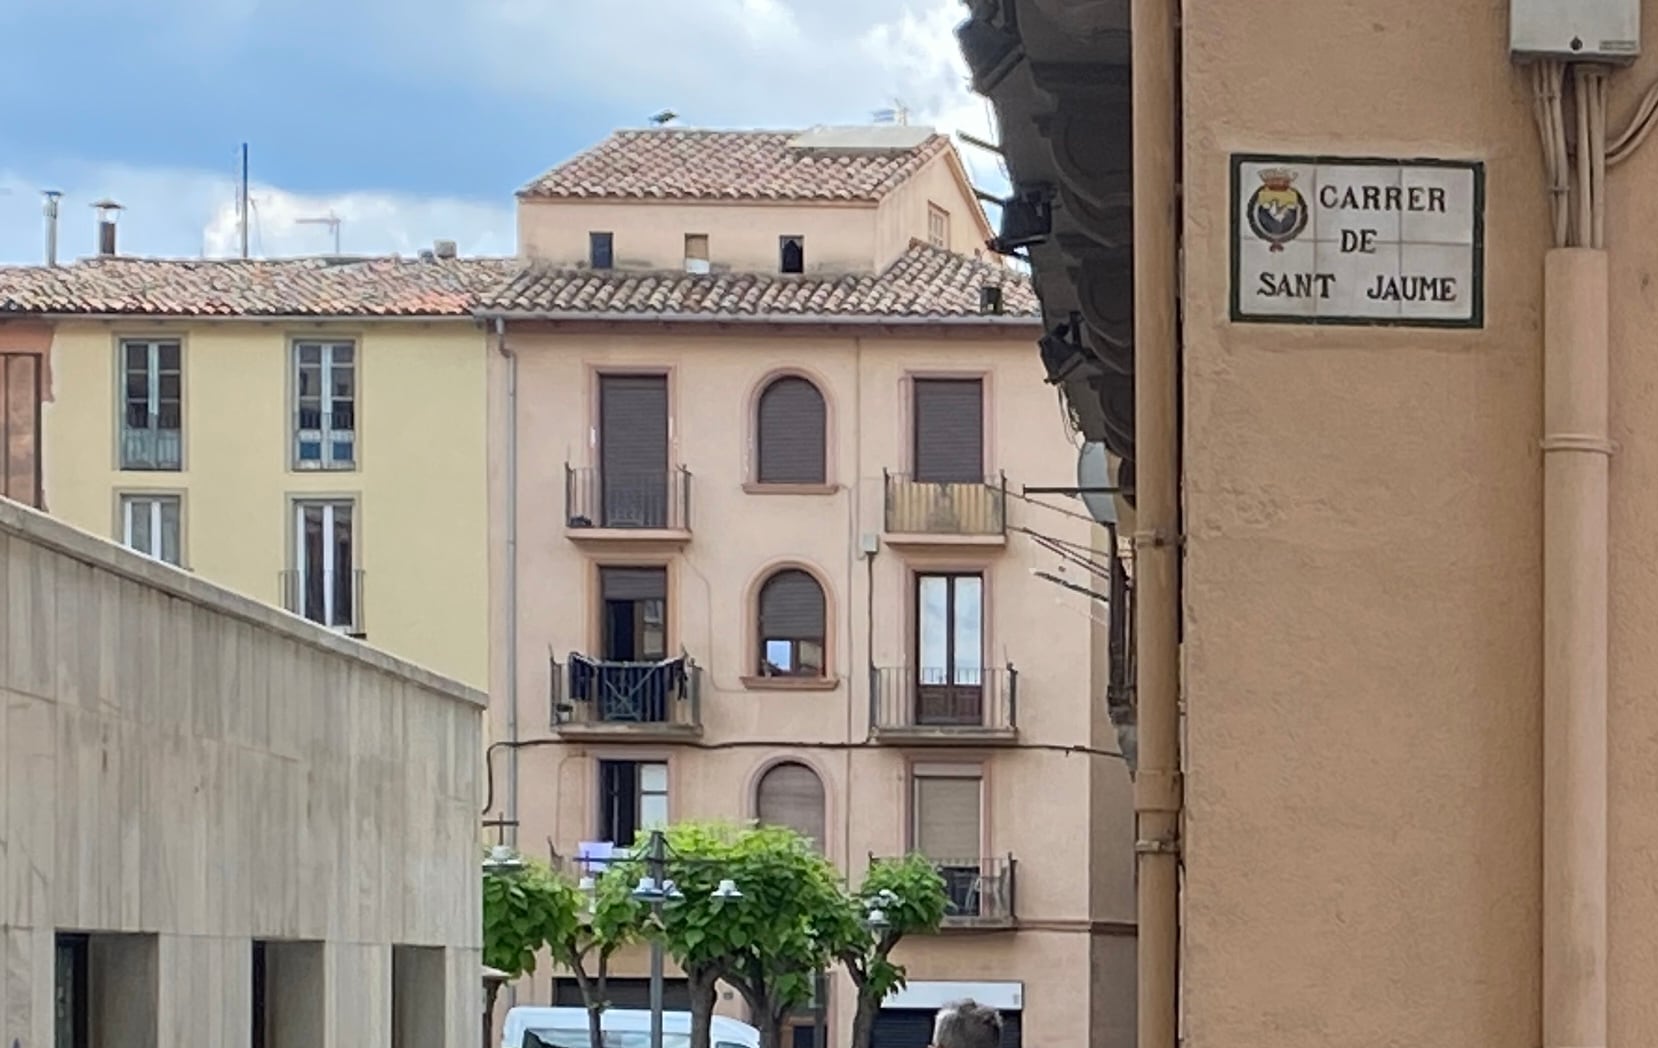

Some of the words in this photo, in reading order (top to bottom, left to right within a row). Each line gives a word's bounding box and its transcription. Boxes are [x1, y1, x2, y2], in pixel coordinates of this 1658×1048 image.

[1319, 185, 1446, 213] CARRER
[1340, 229, 1377, 253] DE
[1257, 272, 1336, 298] SANT
[1367, 275, 1456, 301] JAUME
